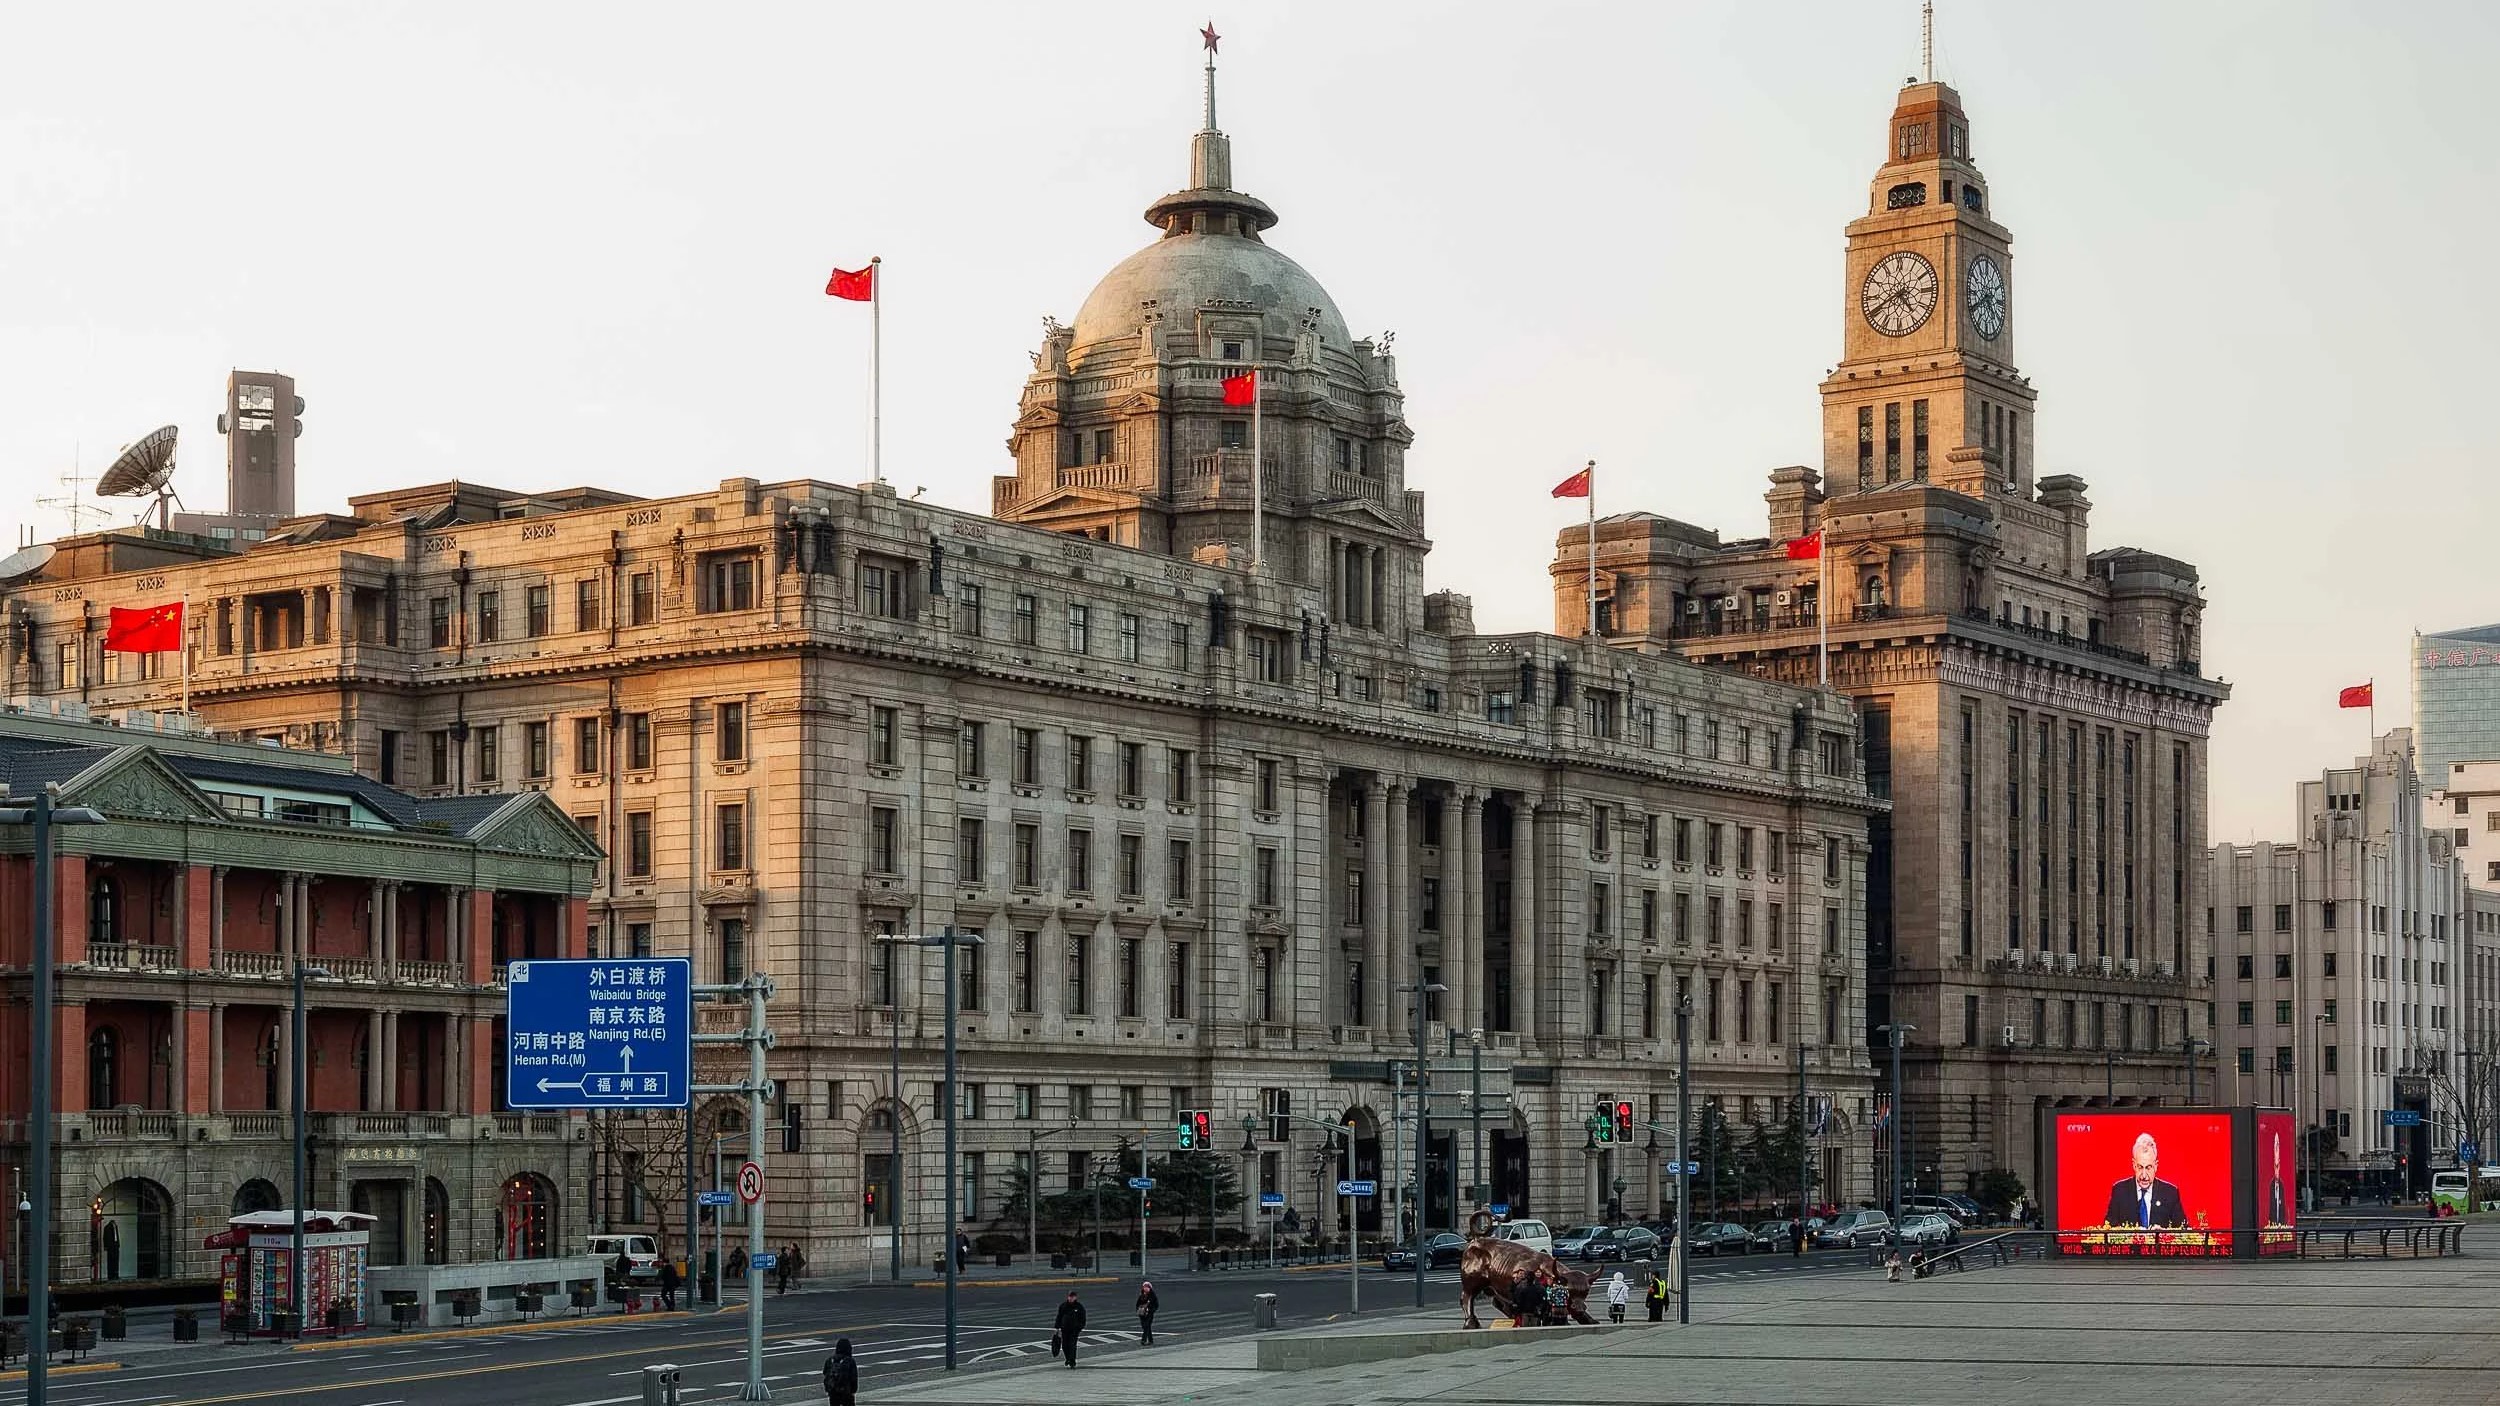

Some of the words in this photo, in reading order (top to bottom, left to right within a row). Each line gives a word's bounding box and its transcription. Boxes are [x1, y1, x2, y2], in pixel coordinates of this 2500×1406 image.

[517, 964, 528, 976] 北
[589, 966, 666, 986] 外白渡桥
[589, 989, 632, 1001] Waibaidu
[636, 989, 666, 1002] Bridge
[589, 1006, 666, 1025] 南京东路
[513, 1032, 586, 1050] 河南中路
[589, 1028, 629, 1042] Nanjing
[633, 1028, 666, 1041] Rd.(E)
[514, 1054, 548, 1066] Henan
[551, 1053, 586, 1067] Rd.(M)
[597, 1077, 658, 1092] 福州路
